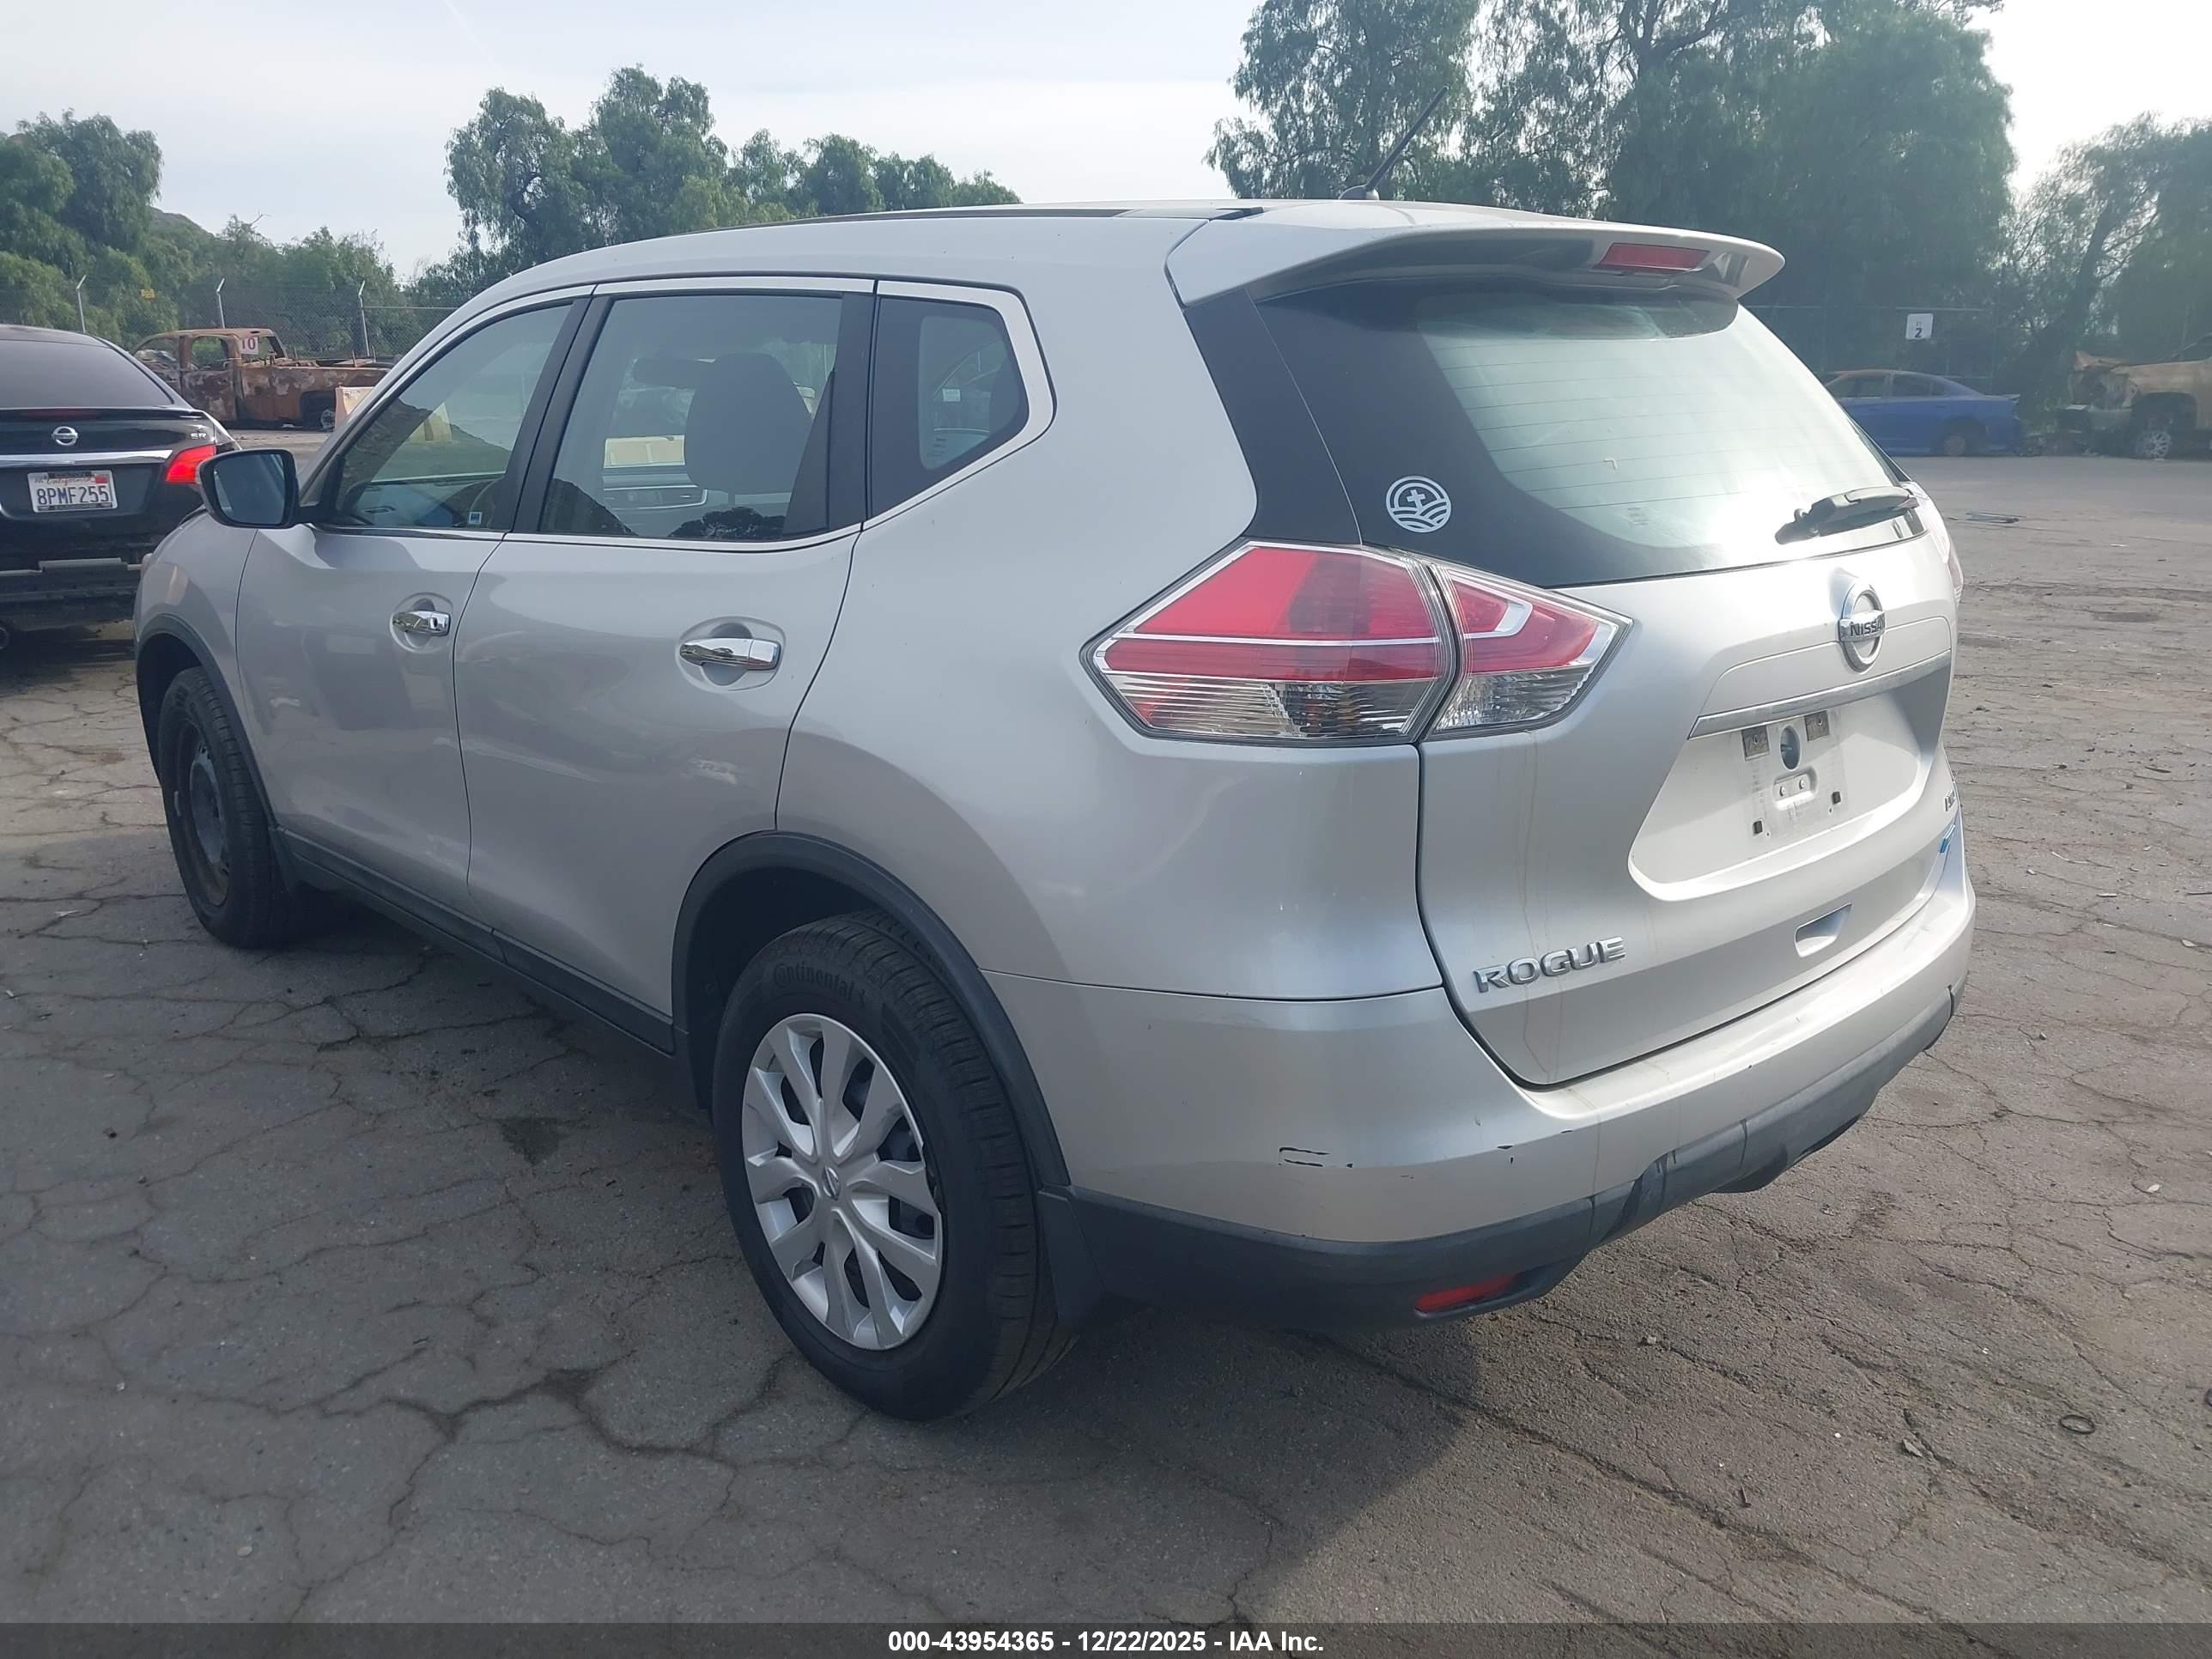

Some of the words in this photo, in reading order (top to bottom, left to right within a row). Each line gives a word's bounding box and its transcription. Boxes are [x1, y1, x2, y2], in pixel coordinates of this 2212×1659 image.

[1915, 327, 1923, 338] 2
[37, 485, 110, 505] 8PMF255
[1473, 935, 1626, 994] ROGUE
